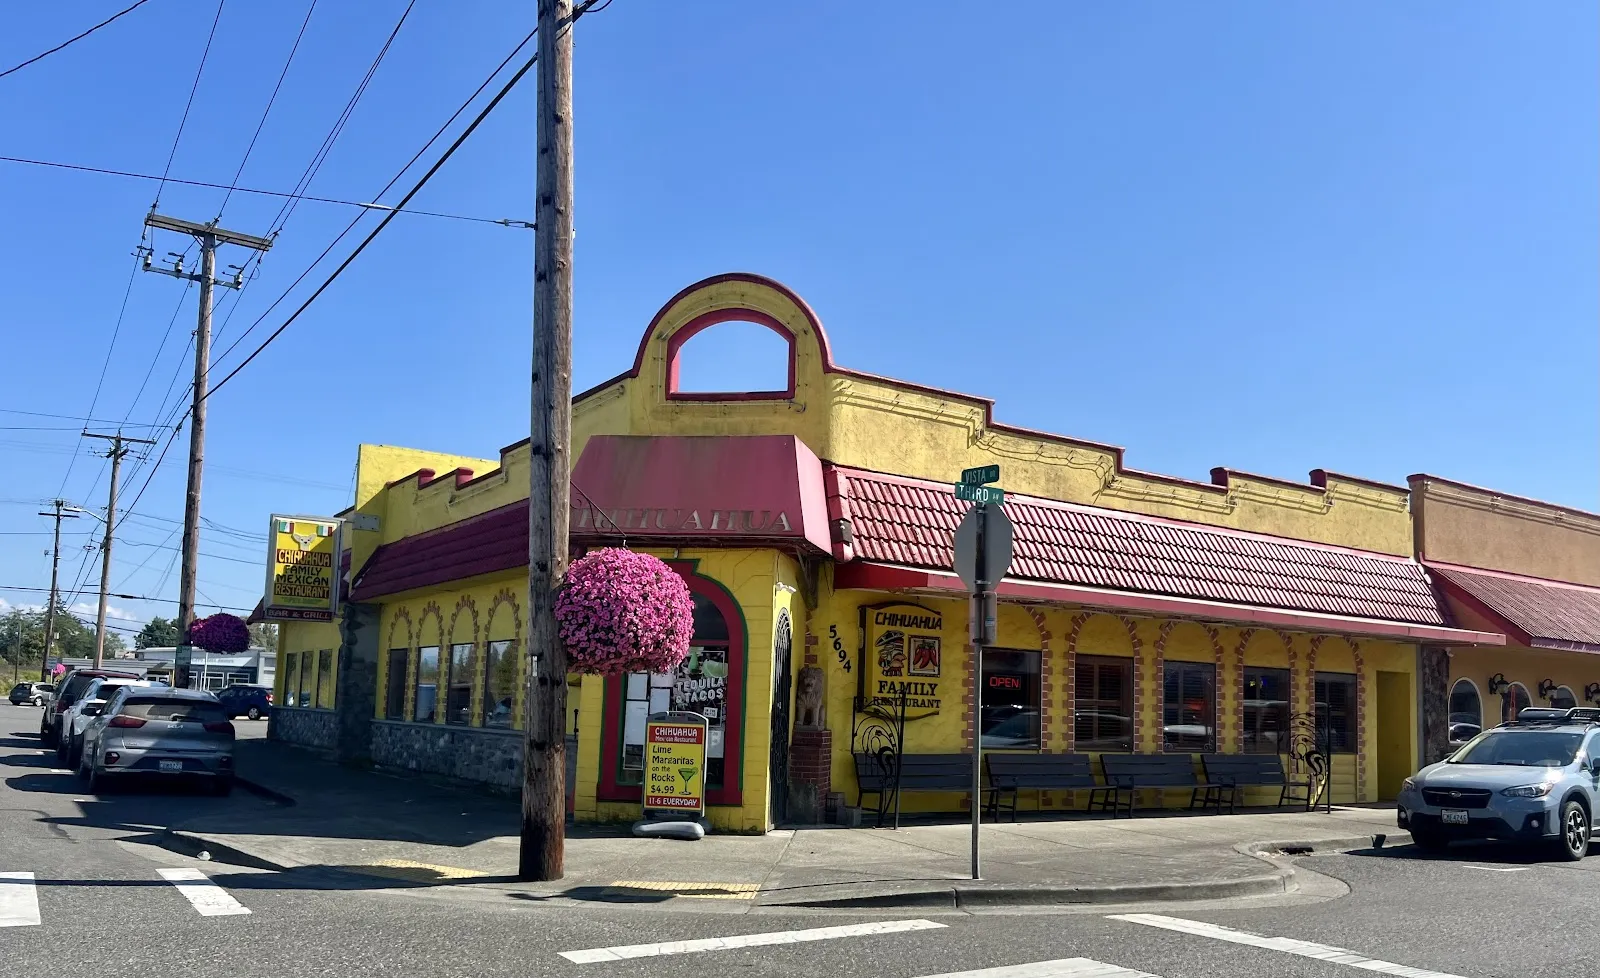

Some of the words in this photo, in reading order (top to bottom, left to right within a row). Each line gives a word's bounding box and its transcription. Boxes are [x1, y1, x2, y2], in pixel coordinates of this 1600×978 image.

[966, 470, 986, 483] VISTA
[960, 485, 988, 501] THIRD
[570, 507, 793, 532] HIHUAHUA
[278, 550, 330, 567] CHIHUAHUA
[285, 565, 322, 576] FAMILY
[276, 574, 328, 586] MEXICAN
[275, 584, 329, 598] RESTAURANT
[875, 612, 942, 630] CHIHUAHUA
[829, 624, 852, 673] 5694
[676, 677, 724, 692] TEQUILA
[877, 680, 939, 696] FAMILY
[990, 677, 1019, 688] OPEN
[685, 688, 724, 703] TACOS
[655, 727, 697, 737] CHIHUAHUA
[652, 745, 672, 754] Lime
[652, 755, 694, 766] Margaritas
[651, 773, 675, 783] Rocks
[650, 784, 675, 794] $4.99
[649, 797, 661, 805] 11-6
[662, 797, 698, 806] EVERYDAY
